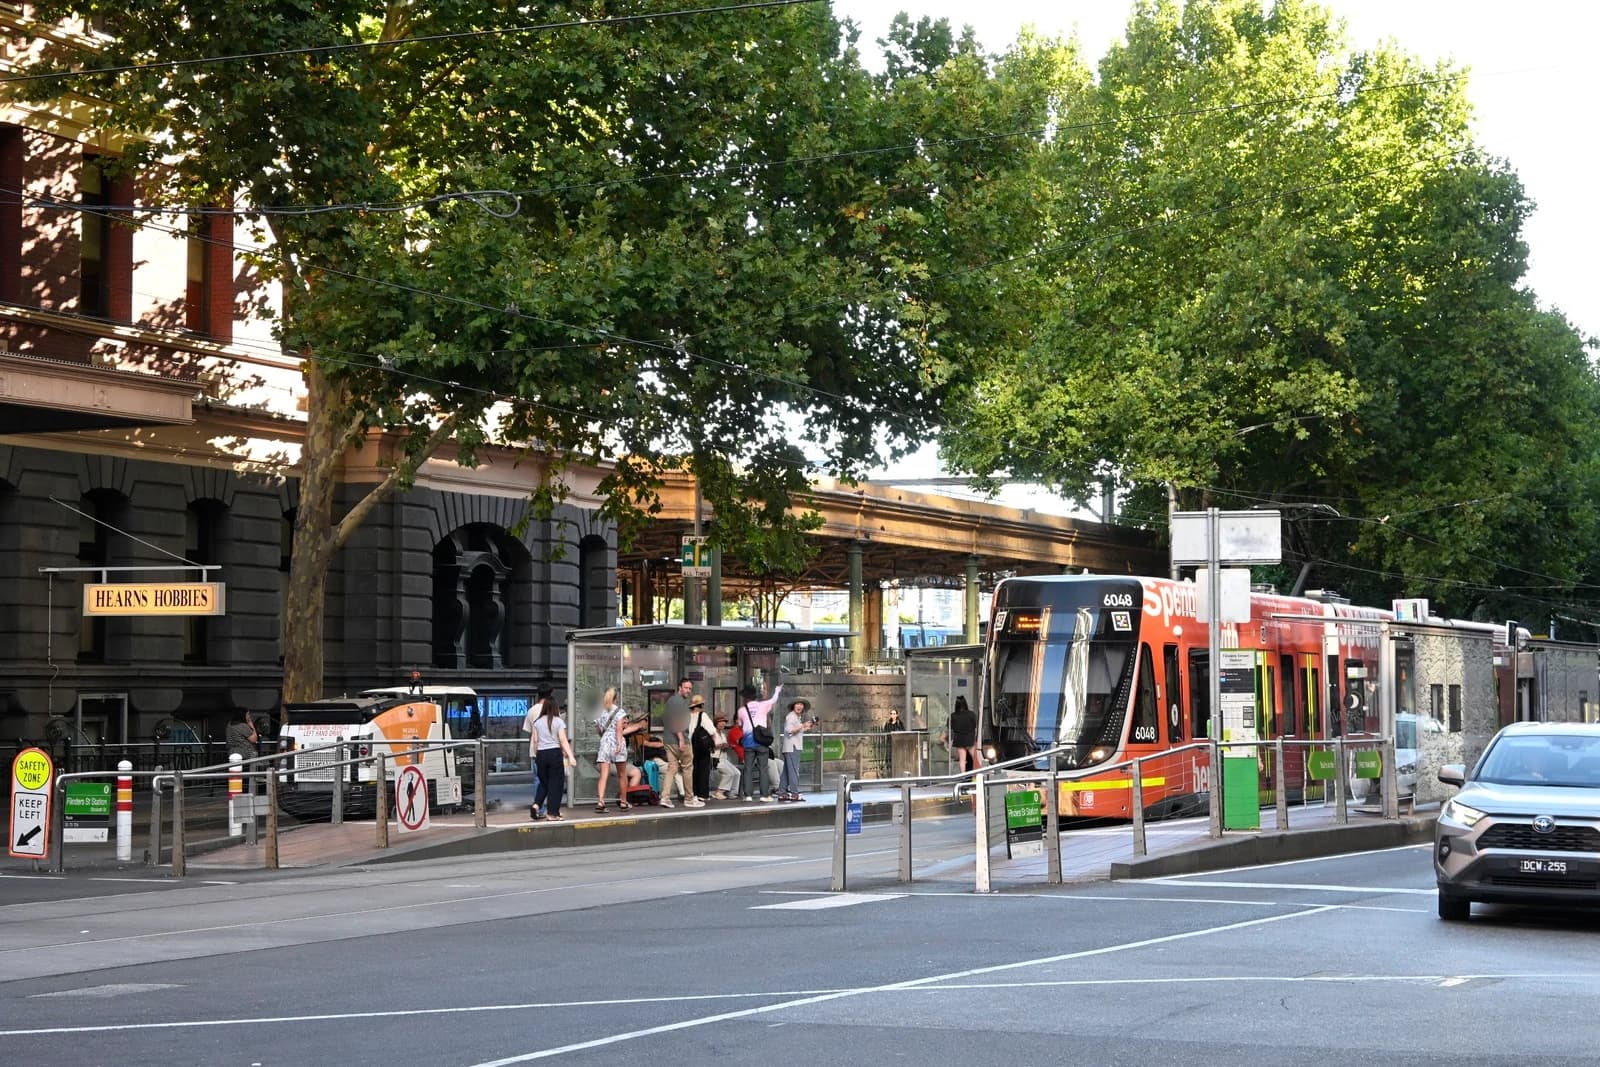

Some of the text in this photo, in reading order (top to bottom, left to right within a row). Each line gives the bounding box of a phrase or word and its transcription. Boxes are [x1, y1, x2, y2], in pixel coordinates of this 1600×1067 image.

[96, 589, 208, 607] HEARNS HOBBIES
[1103, 593, 1132, 607] 6048
[1135, 727, 1155, 740] 6048
[20, 760, 45, 771] SAFETY
[23, 773, 42, 783] ZONE
[19, 799, 42, 808] KEEP
[19, 810, 40, 820] LEFT
